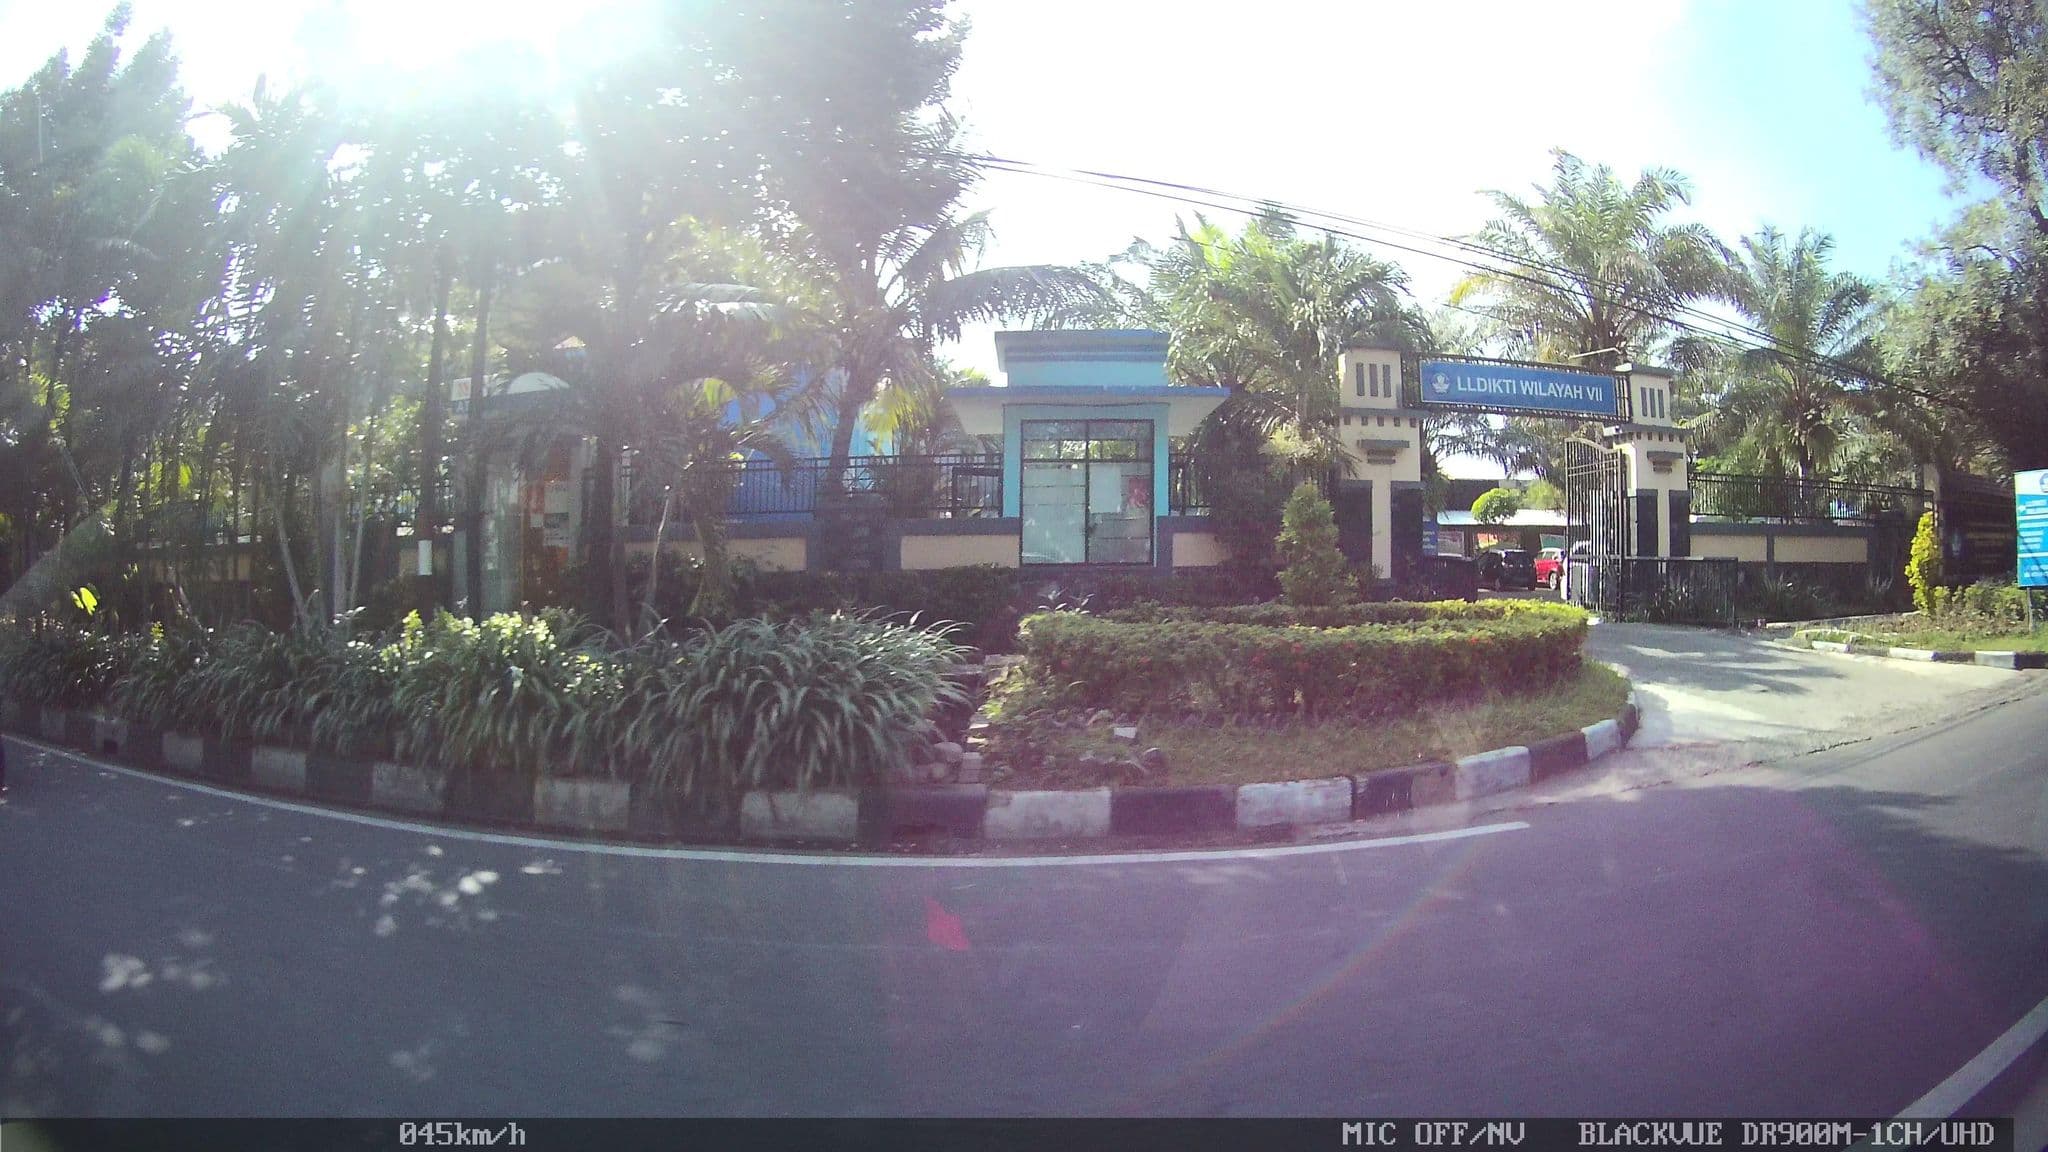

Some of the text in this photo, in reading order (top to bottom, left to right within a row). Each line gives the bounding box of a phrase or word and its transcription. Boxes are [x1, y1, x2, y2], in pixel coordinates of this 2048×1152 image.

[1457, 376, 1603, 402] LLDIKTI WILAYAH VII
